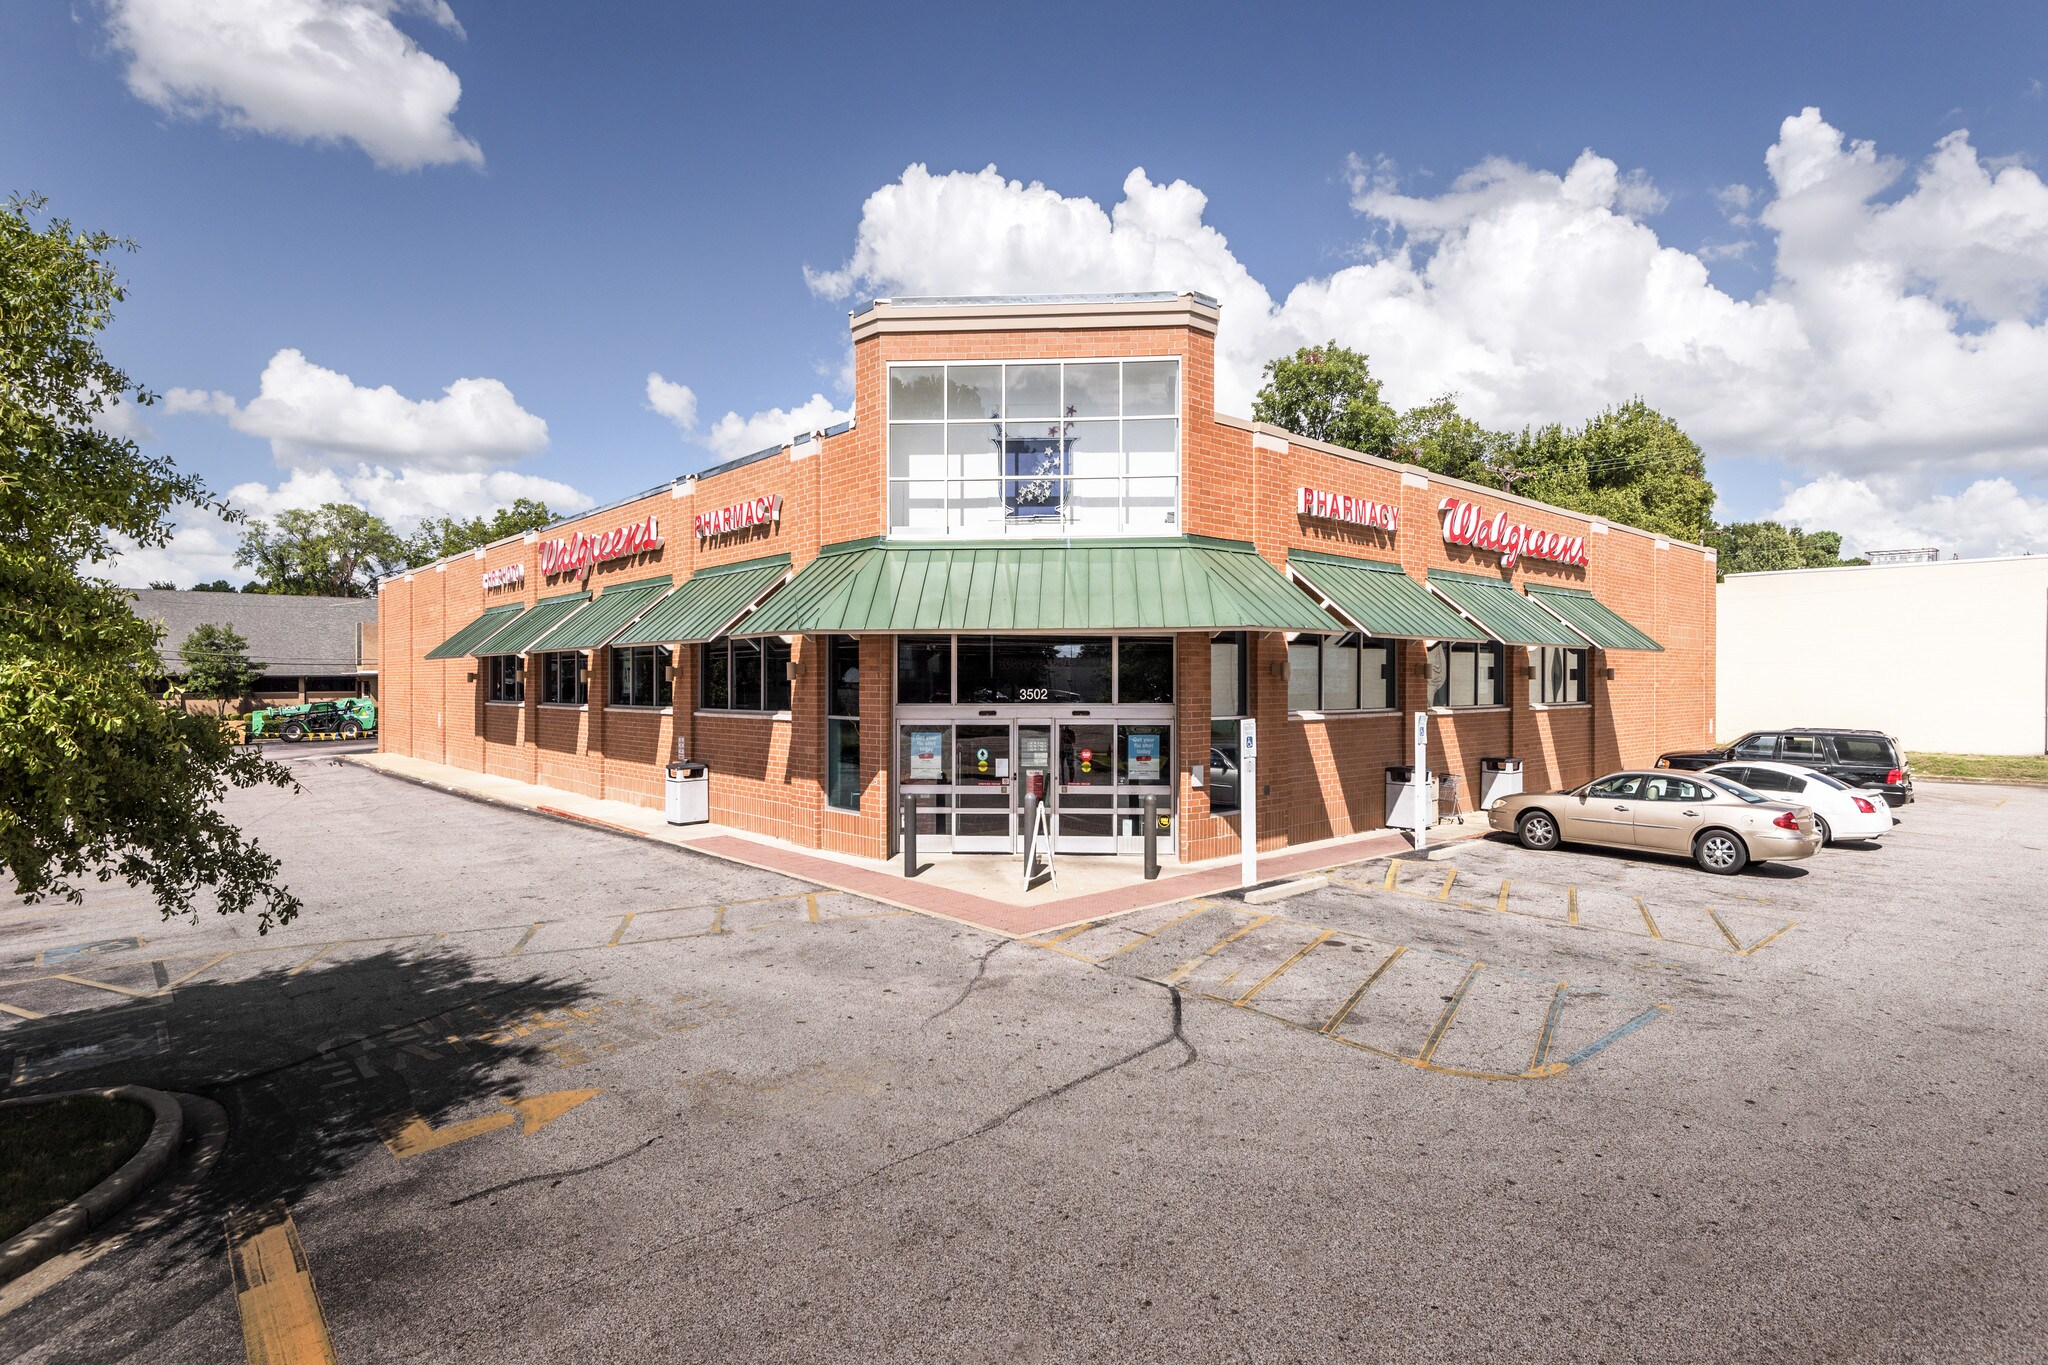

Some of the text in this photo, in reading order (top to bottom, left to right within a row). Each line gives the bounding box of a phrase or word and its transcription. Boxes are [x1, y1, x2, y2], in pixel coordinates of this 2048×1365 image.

[695, 494, 780, 539] PHARMACY
[1299, 487, 1399, 530] PHARMACY
[539, 516, 663, 581] Walgreens
[1438, 498, 1590, 568] Walgreens
[1019, 688, 1048, 700] 3502
